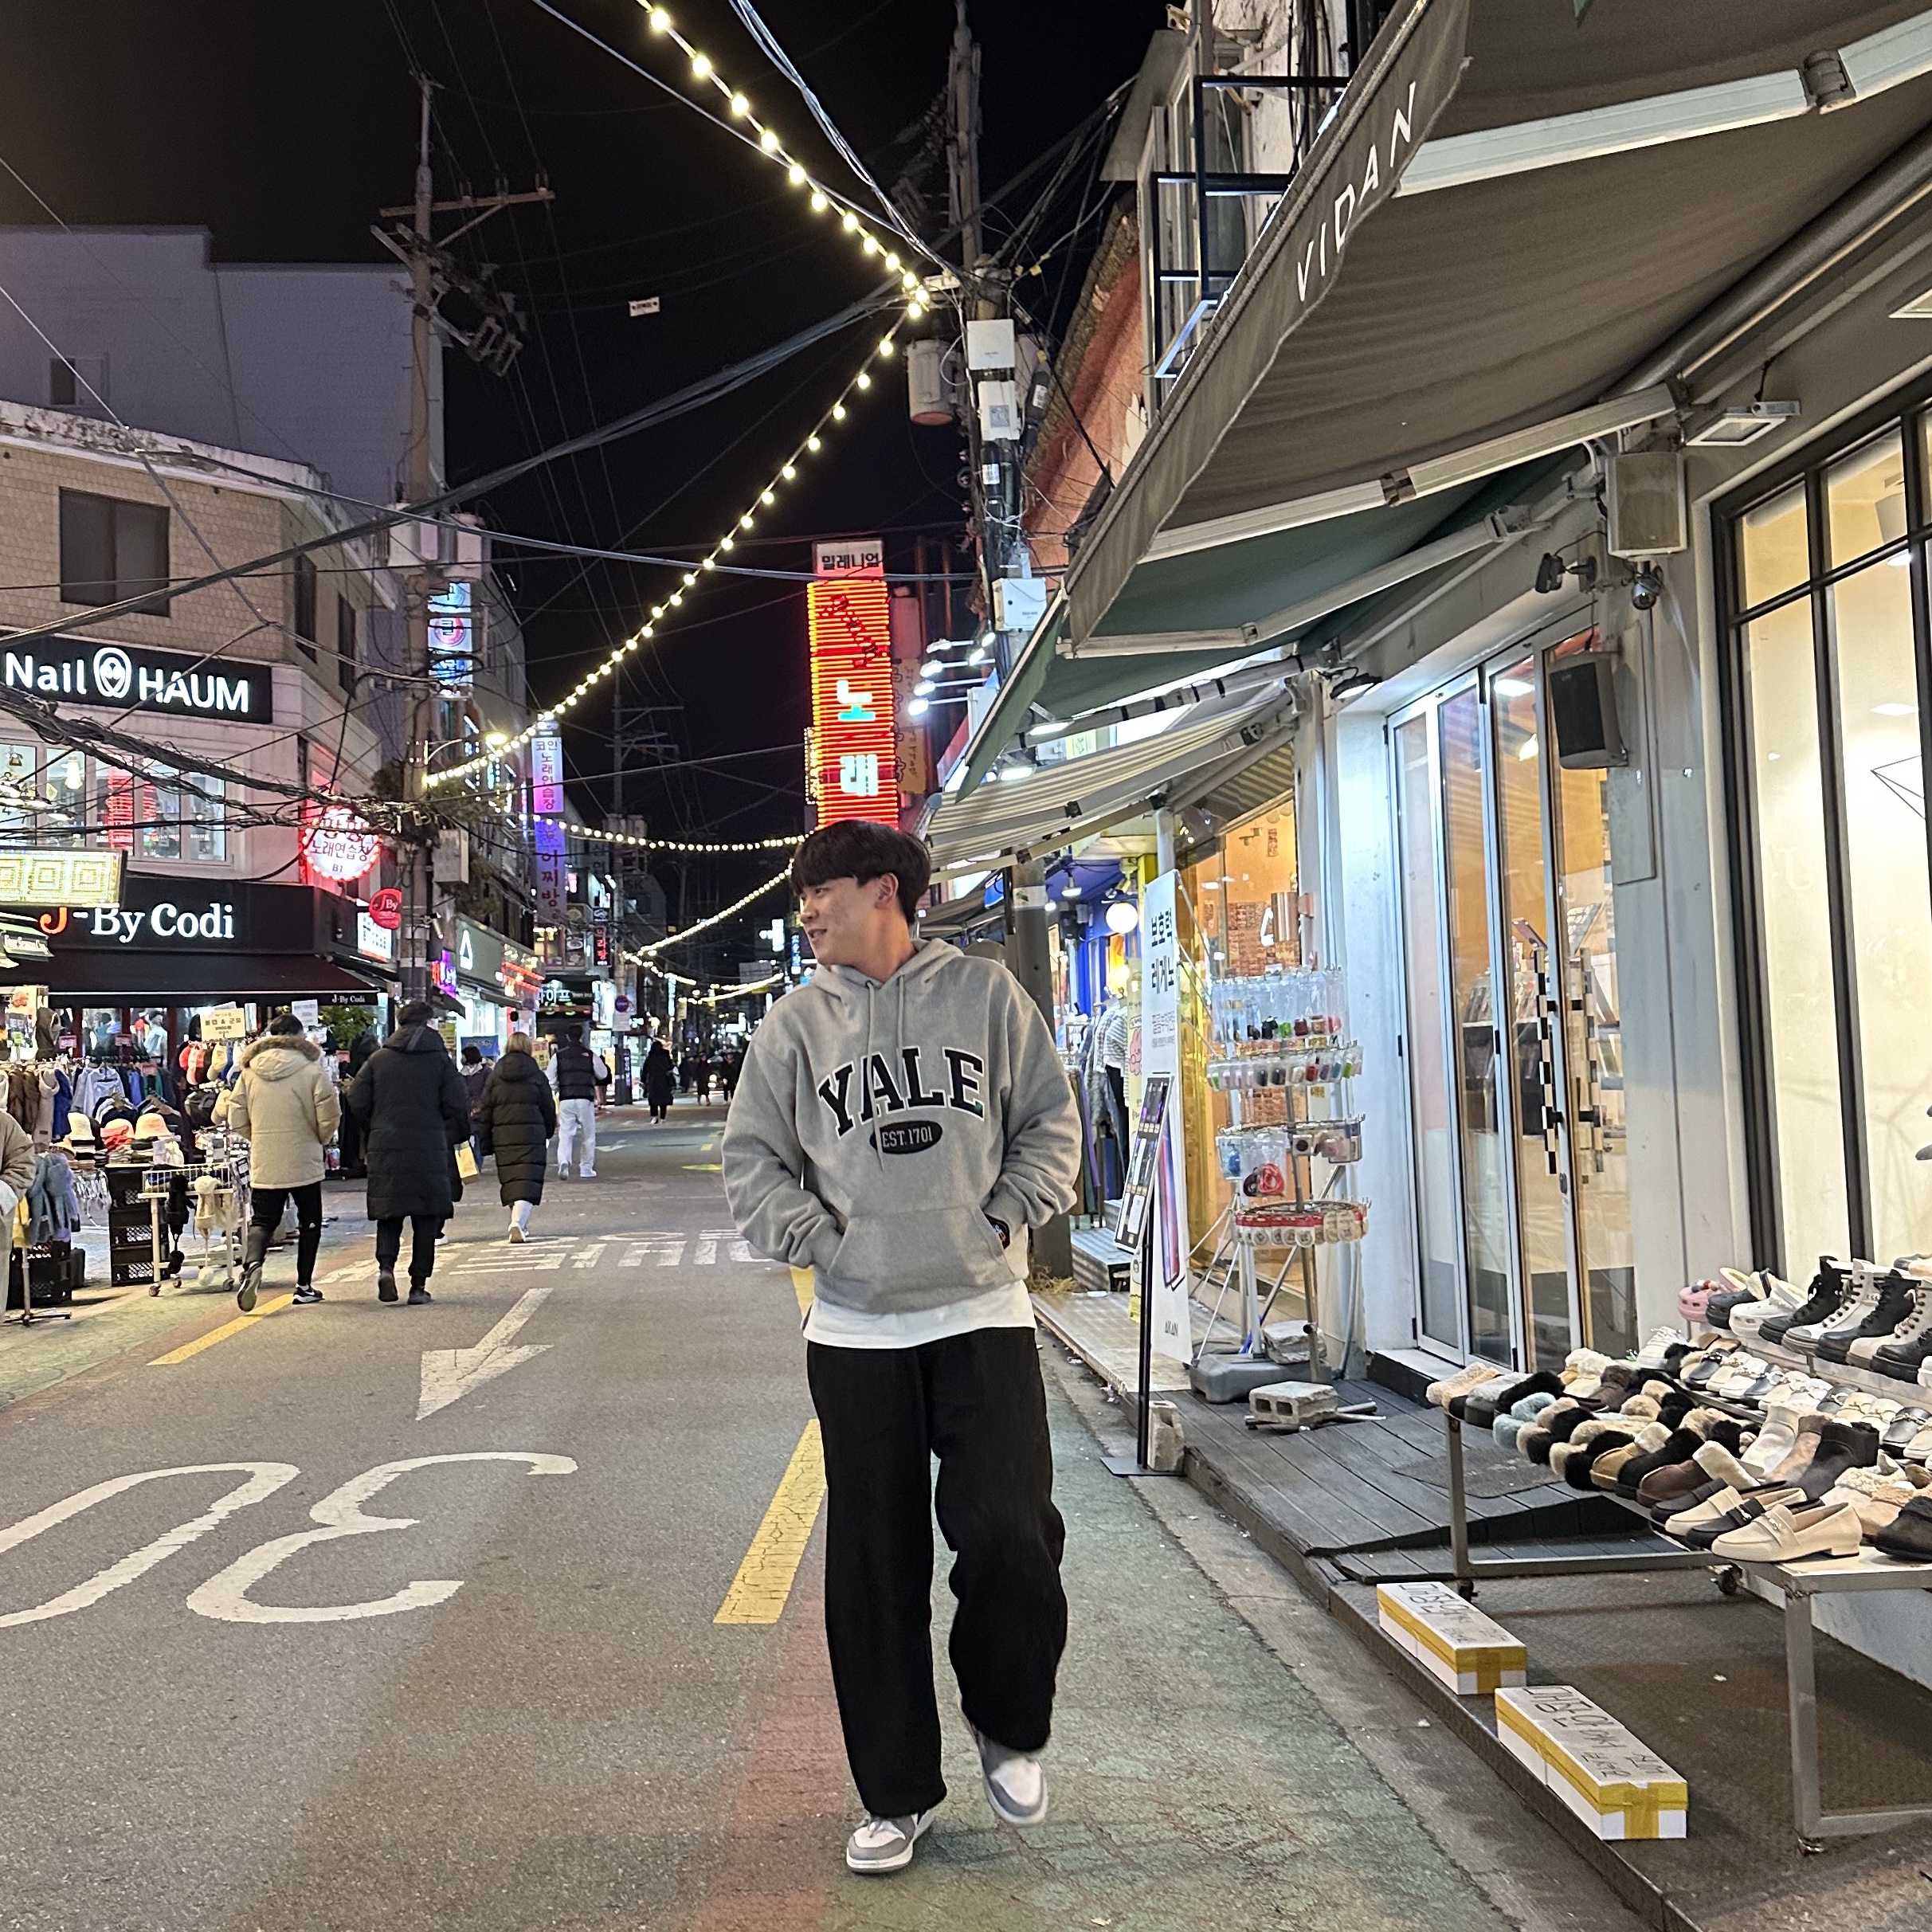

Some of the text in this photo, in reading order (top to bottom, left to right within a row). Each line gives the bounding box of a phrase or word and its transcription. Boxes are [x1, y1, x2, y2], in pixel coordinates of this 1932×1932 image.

[1296, 80, 1417, 302] VIDAN
[821, 553, 879, 570] 밀레니엄
[5, 652, 249, 713] Nail HAUM
[535, 740, 558, 751] 코인
[837, 680, 879, 797] 노래
[310, 840, 370, 862] 노래연습장
[151, 903, 235, 939] Codi
[817, 1046, 985, 1139] YALE
